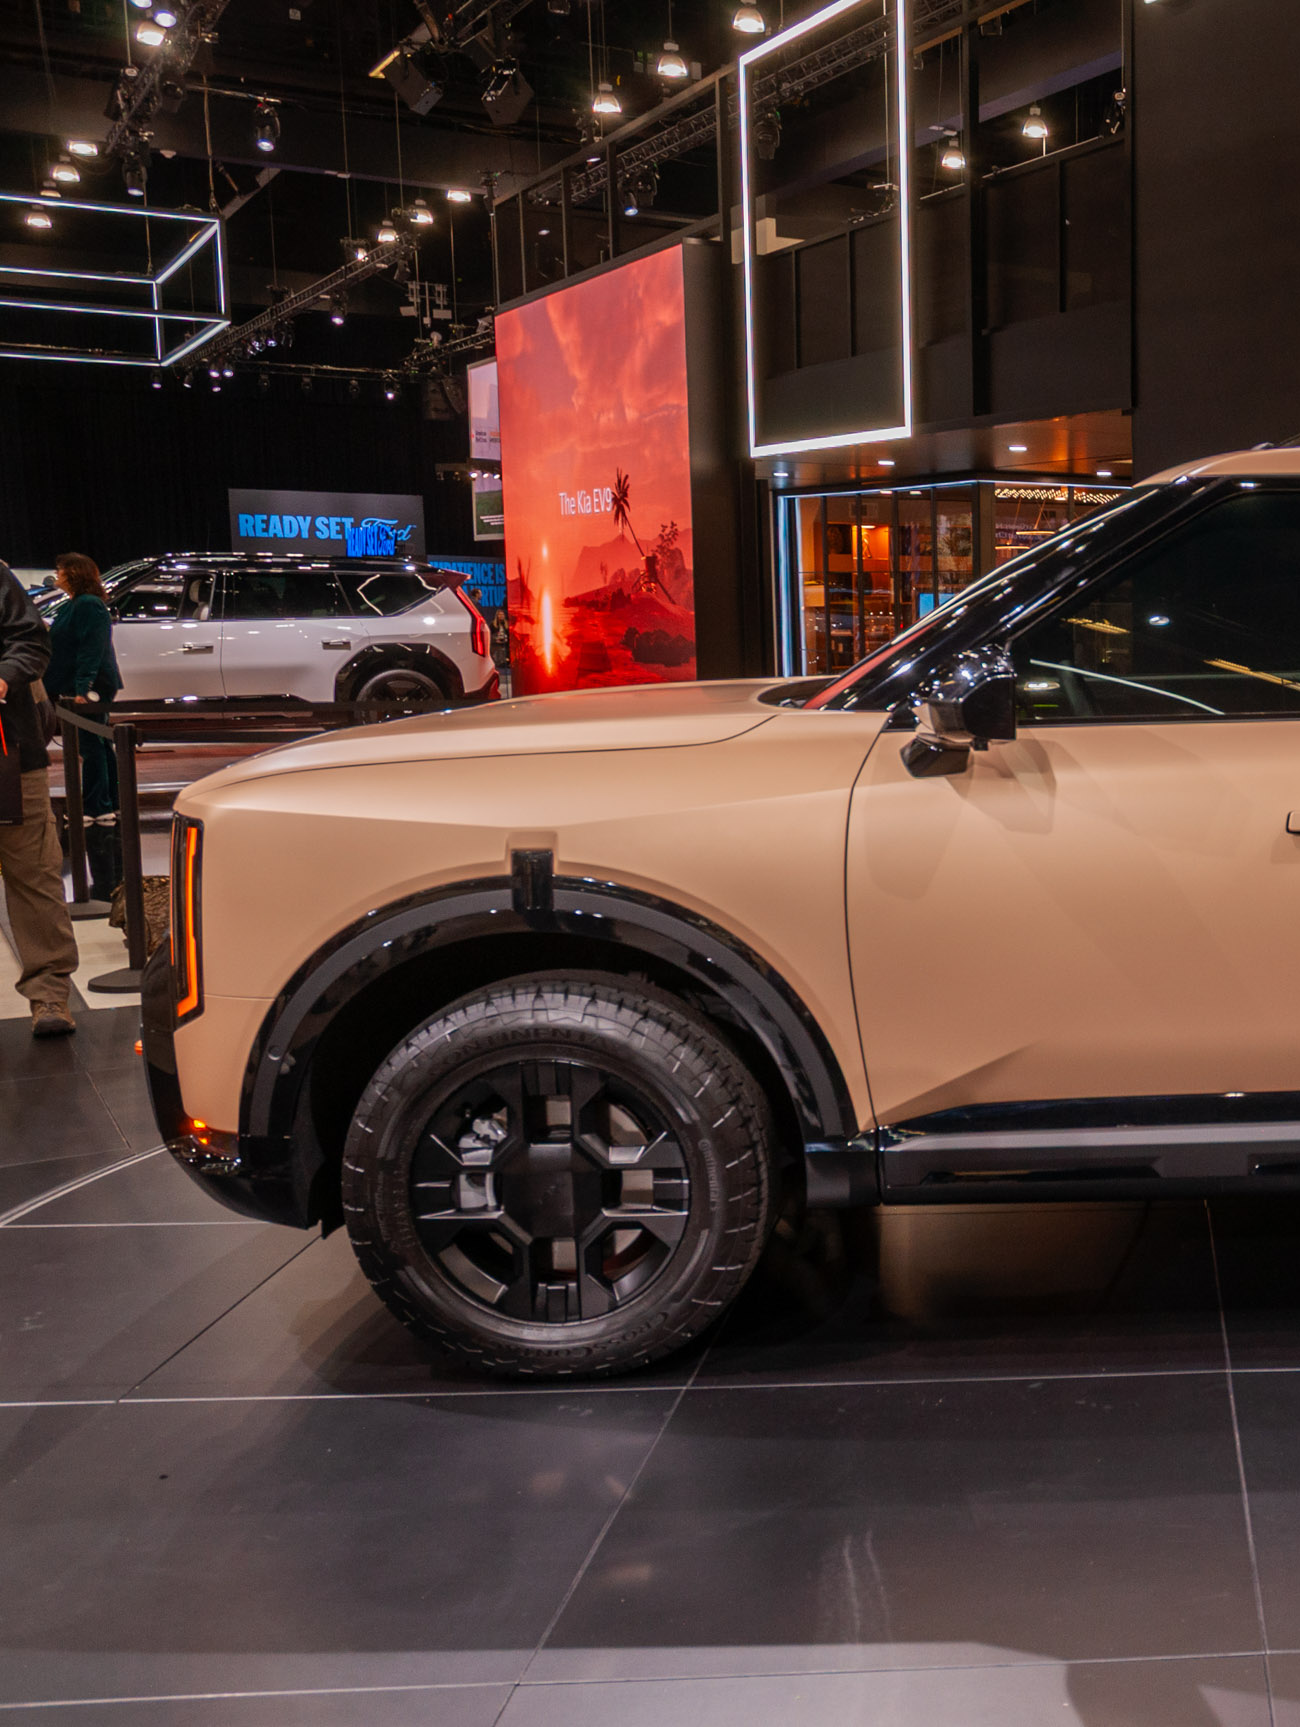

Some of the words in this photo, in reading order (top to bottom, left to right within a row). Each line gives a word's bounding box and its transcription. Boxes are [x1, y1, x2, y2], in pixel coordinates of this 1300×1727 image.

[559, 492, 576, 515] The
[577, 490, 591, 514] Kia
[593, 488, 612, 513] EV9
[238, 514, 312, 539] READY
[315, 516, 354, 540] SET
[429, 561, 494, 584] TIENCE
[495, 564, 506, 585] IS
